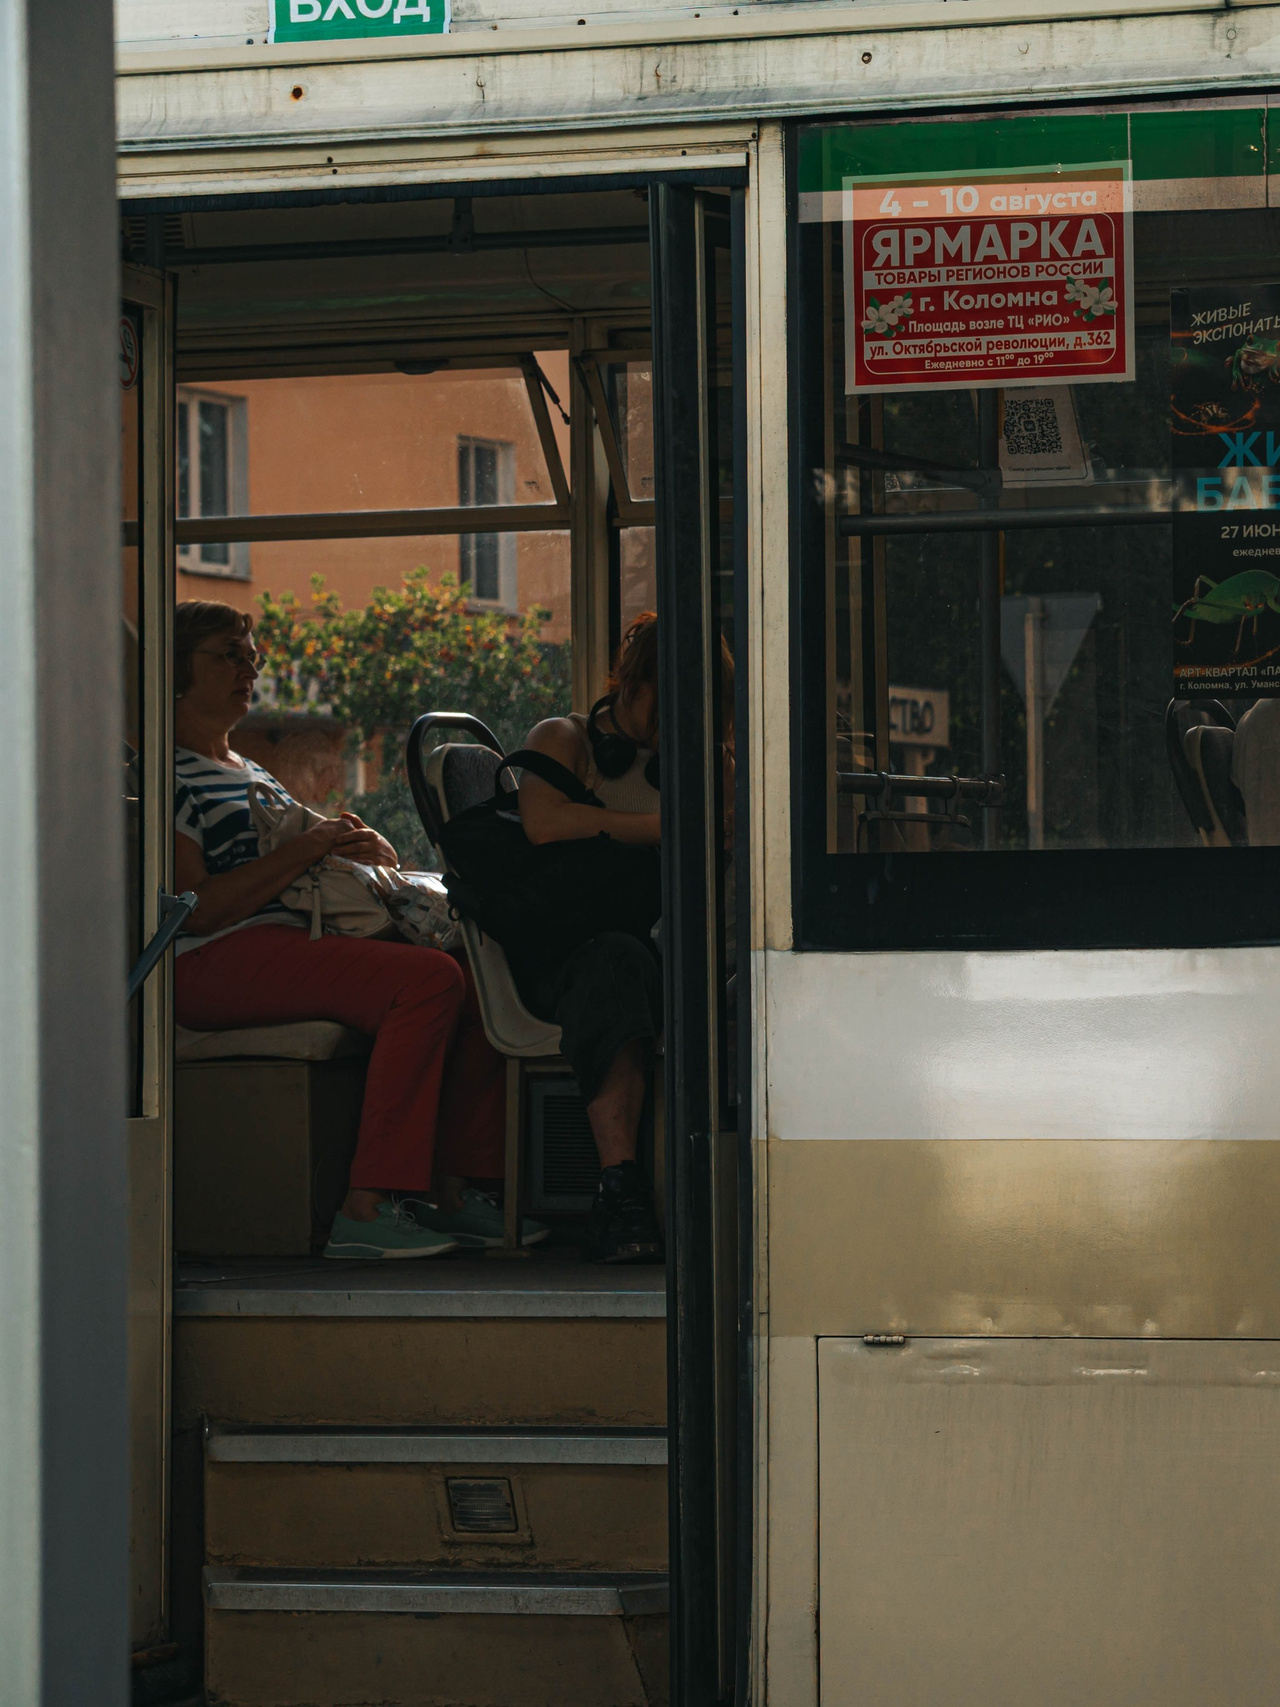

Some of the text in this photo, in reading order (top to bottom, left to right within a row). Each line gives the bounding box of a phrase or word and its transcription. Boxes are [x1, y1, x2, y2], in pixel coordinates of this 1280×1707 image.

[879, 190, 902, 217] 4
[940, 185, 980, 214] 10
[990, 190, 1097, 214] августа
[872, 218, 1106, 268] ЯРМАРКА
[875, 261, 1104, 287] ТОВАРЫ РЕГИОНОВ РОССИИ
[919, 288, 1058, 312] г. Коломна
[908, 312, 1070, 334] Площадь возле ТЦ «РИО»
[1190, 302, 1252, 328] ЖИВЫЕ
[869, 330, 1111, 360] ул. Октябрьской революции, д.362
[924, 357, 985, 370] Ежедневно
[987, 358, 995, 367] с
[1017, 355, 1031, 367] до
[1221, 525, 1239, 539] 27
[1179, 666, 1258, 678] АРТ-КВАРТАЛ
[1179, 682, 1186, 690] г.
[1187, 680, 1233, 691] Коломна,
[1234, 681, 1249, 692] ул.
